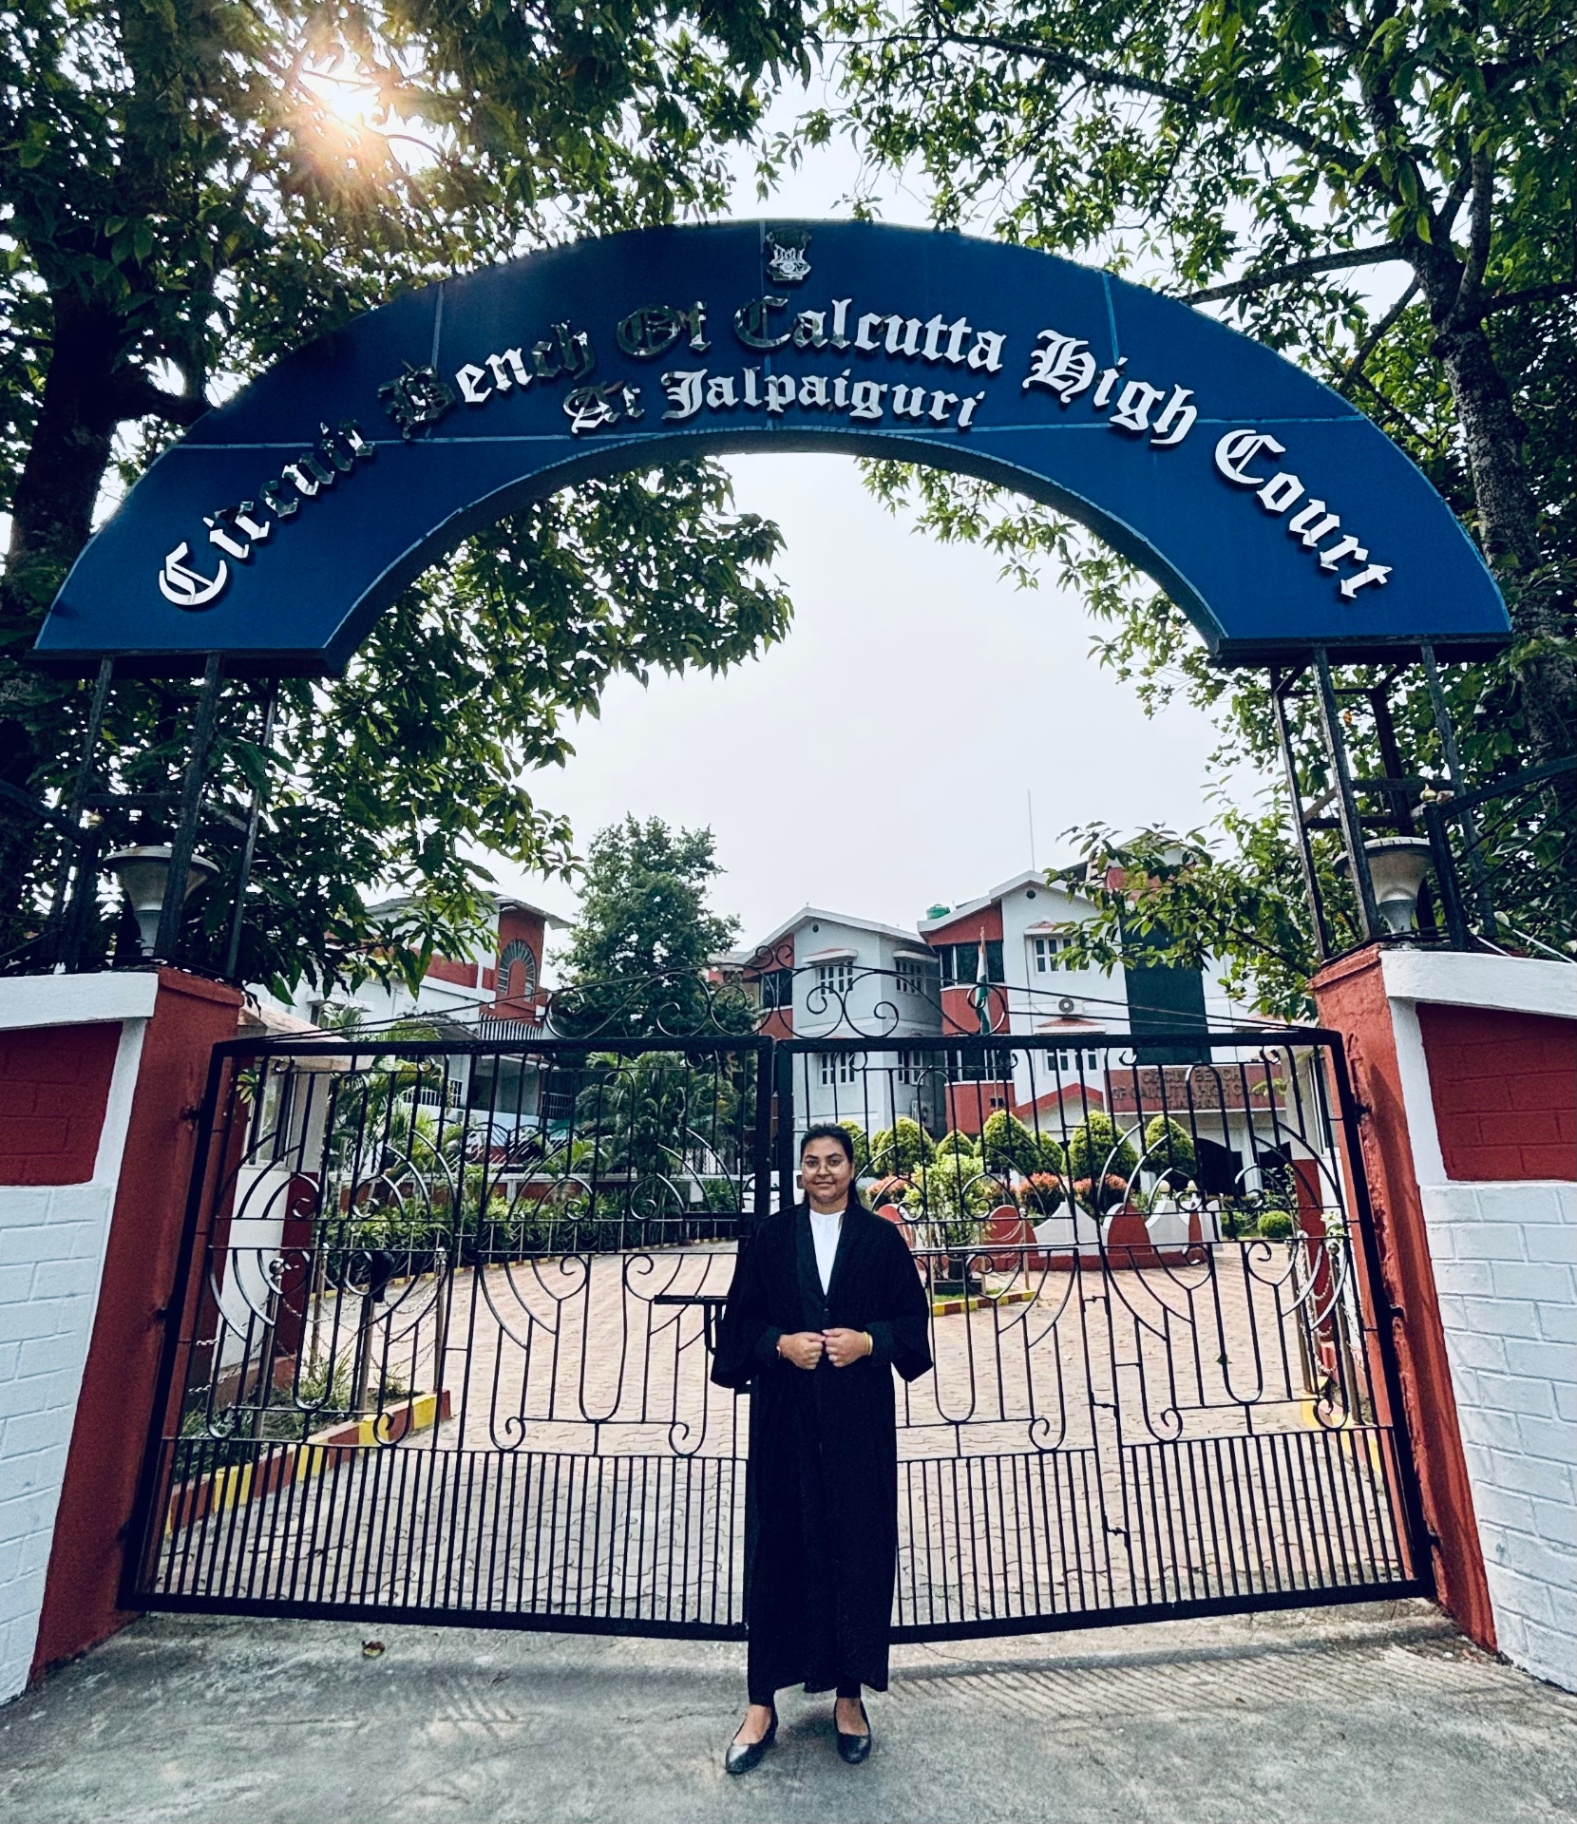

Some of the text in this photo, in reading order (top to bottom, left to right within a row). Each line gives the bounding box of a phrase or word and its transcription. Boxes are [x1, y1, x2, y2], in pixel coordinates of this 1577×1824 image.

[159, 296, 1393, 605] Circuit Bench Of Calcutta High Court
[563, 366, 985, 434] At Jalpaiguri
